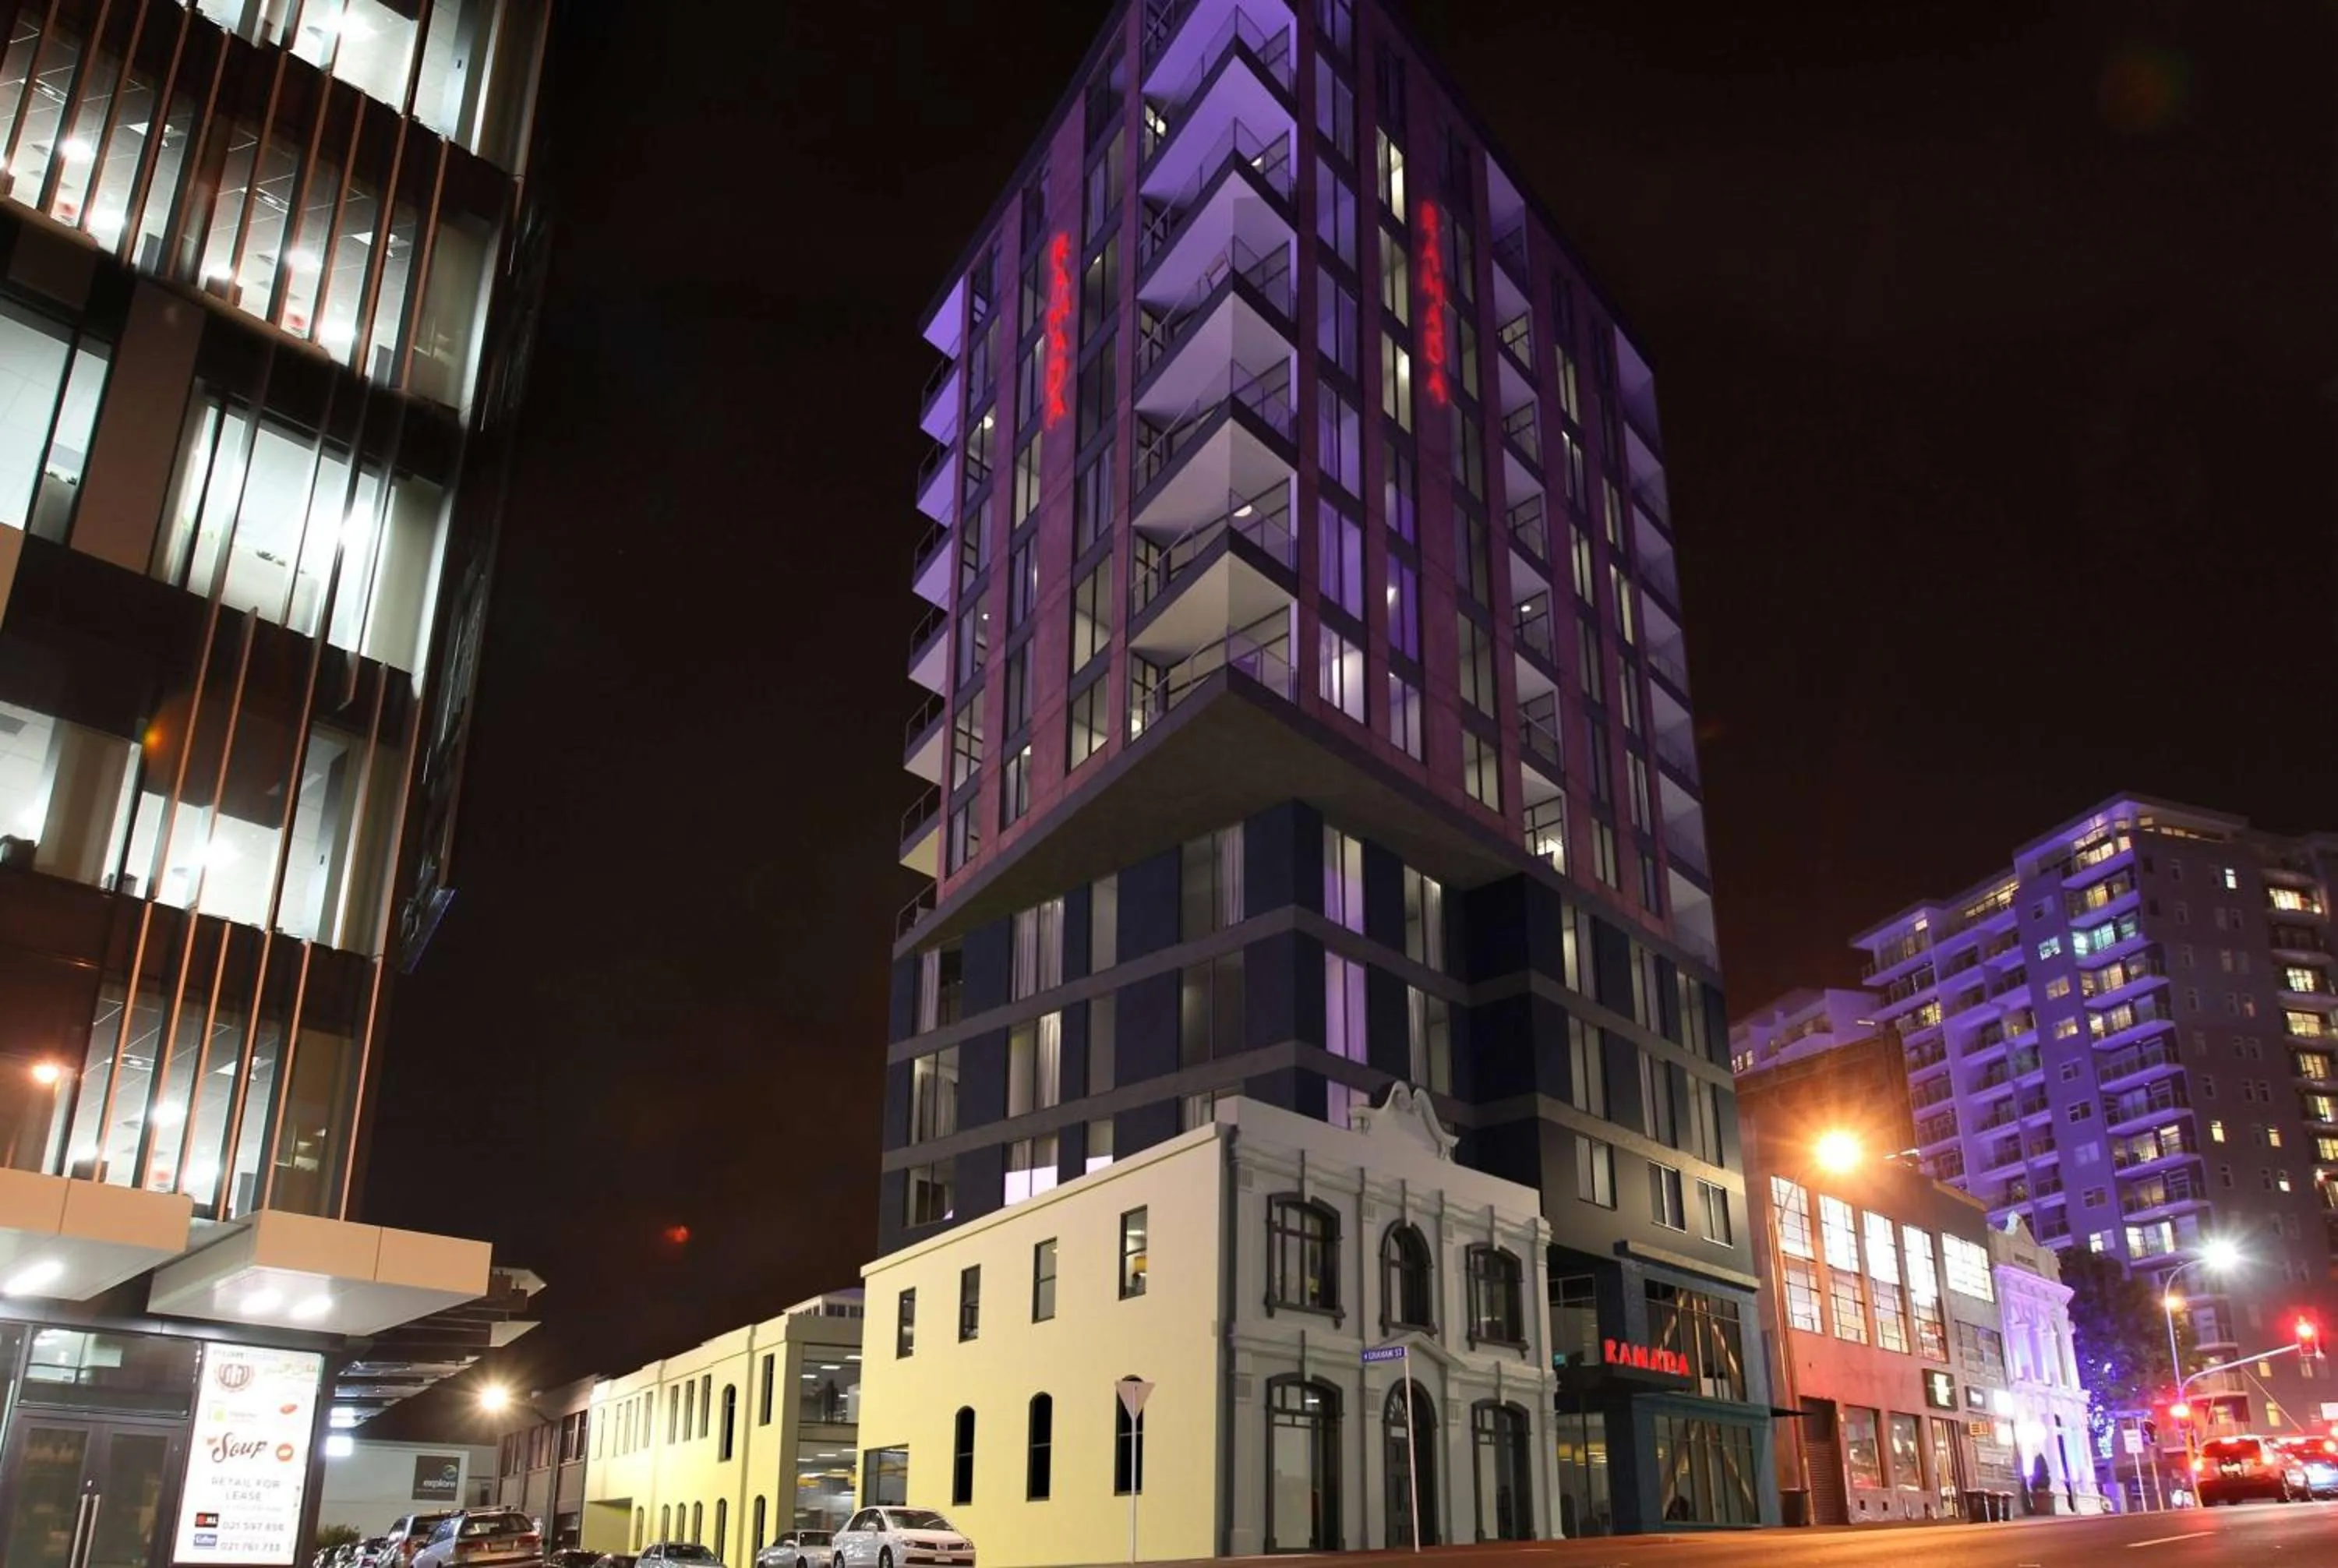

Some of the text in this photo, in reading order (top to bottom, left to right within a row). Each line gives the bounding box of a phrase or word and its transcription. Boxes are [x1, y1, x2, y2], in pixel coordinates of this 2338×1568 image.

[1604, 1338, 1691, 1376] RAMADA
[212, 1432, 268, 1464] Soup
[211, 1476, 281, 1489] RETAIL FOR
[225, 1490, 262, 1502] LEASE
